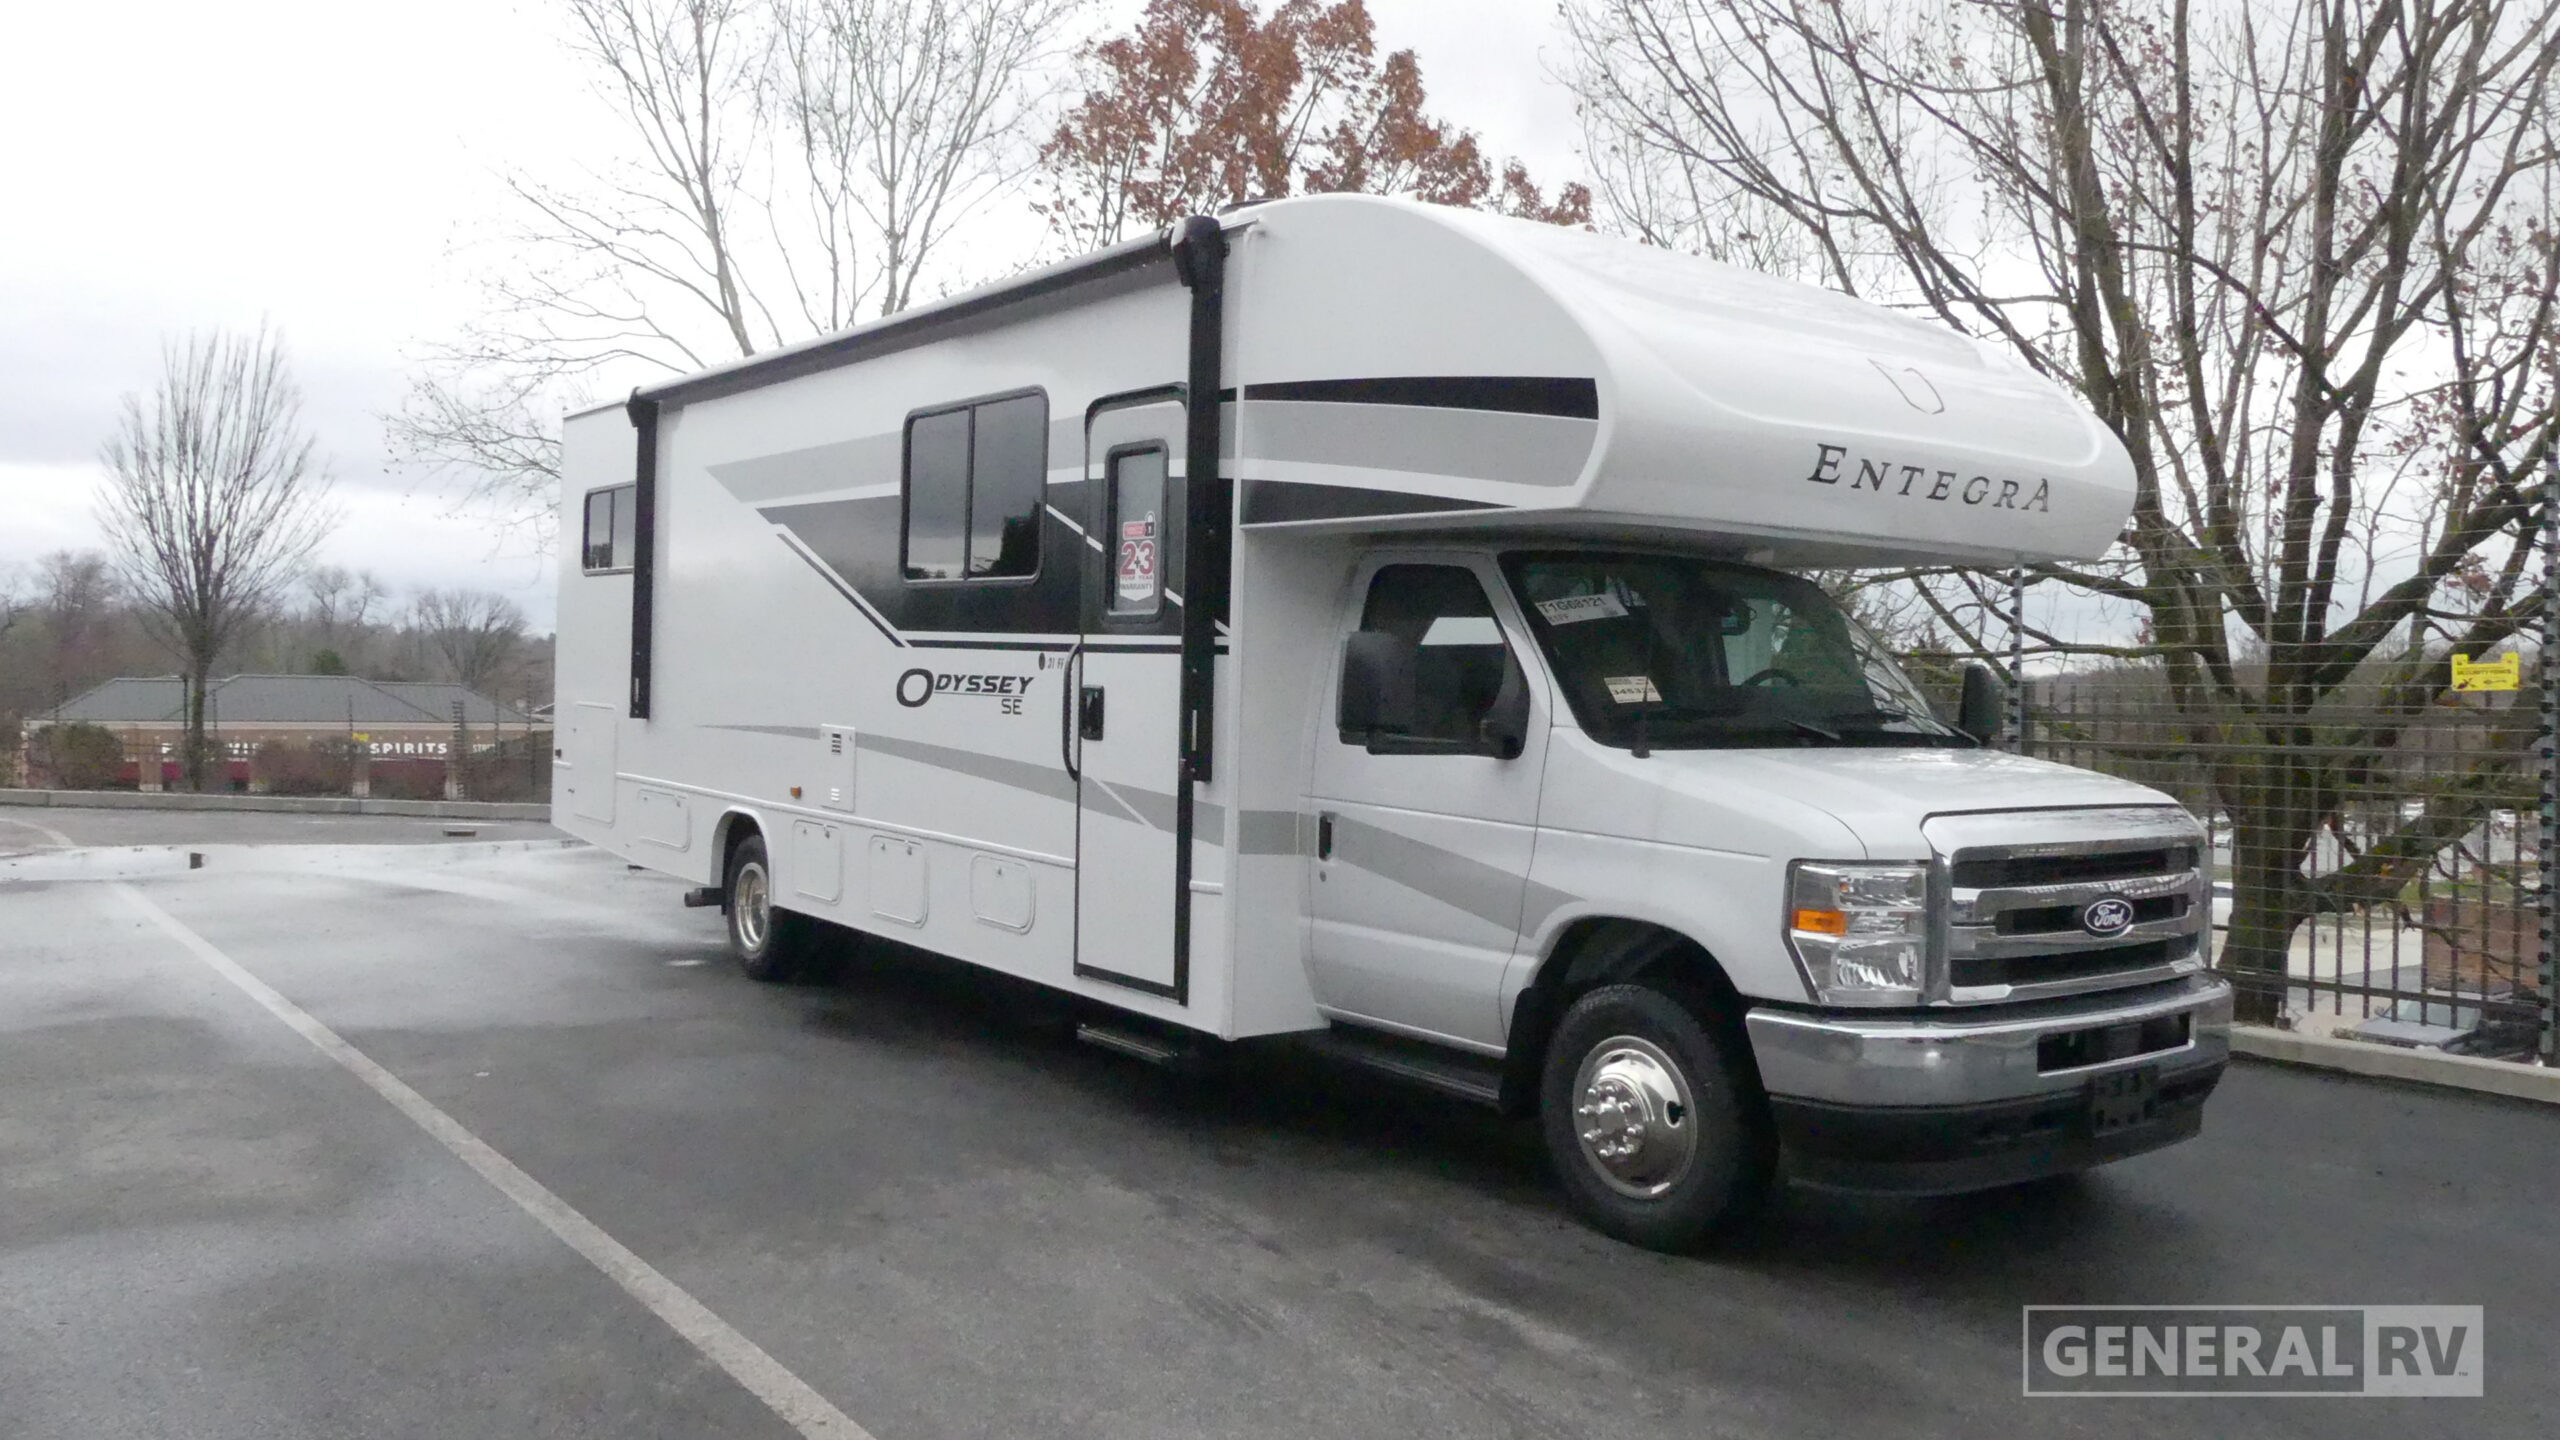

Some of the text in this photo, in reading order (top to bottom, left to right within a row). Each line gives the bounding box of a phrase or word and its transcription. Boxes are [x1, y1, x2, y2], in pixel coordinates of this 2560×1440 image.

[1001, 698, 1023, 715] SE
[369, 742, 448, 755] SPIRITS
[2094, 903, 2126, 927] Ford
